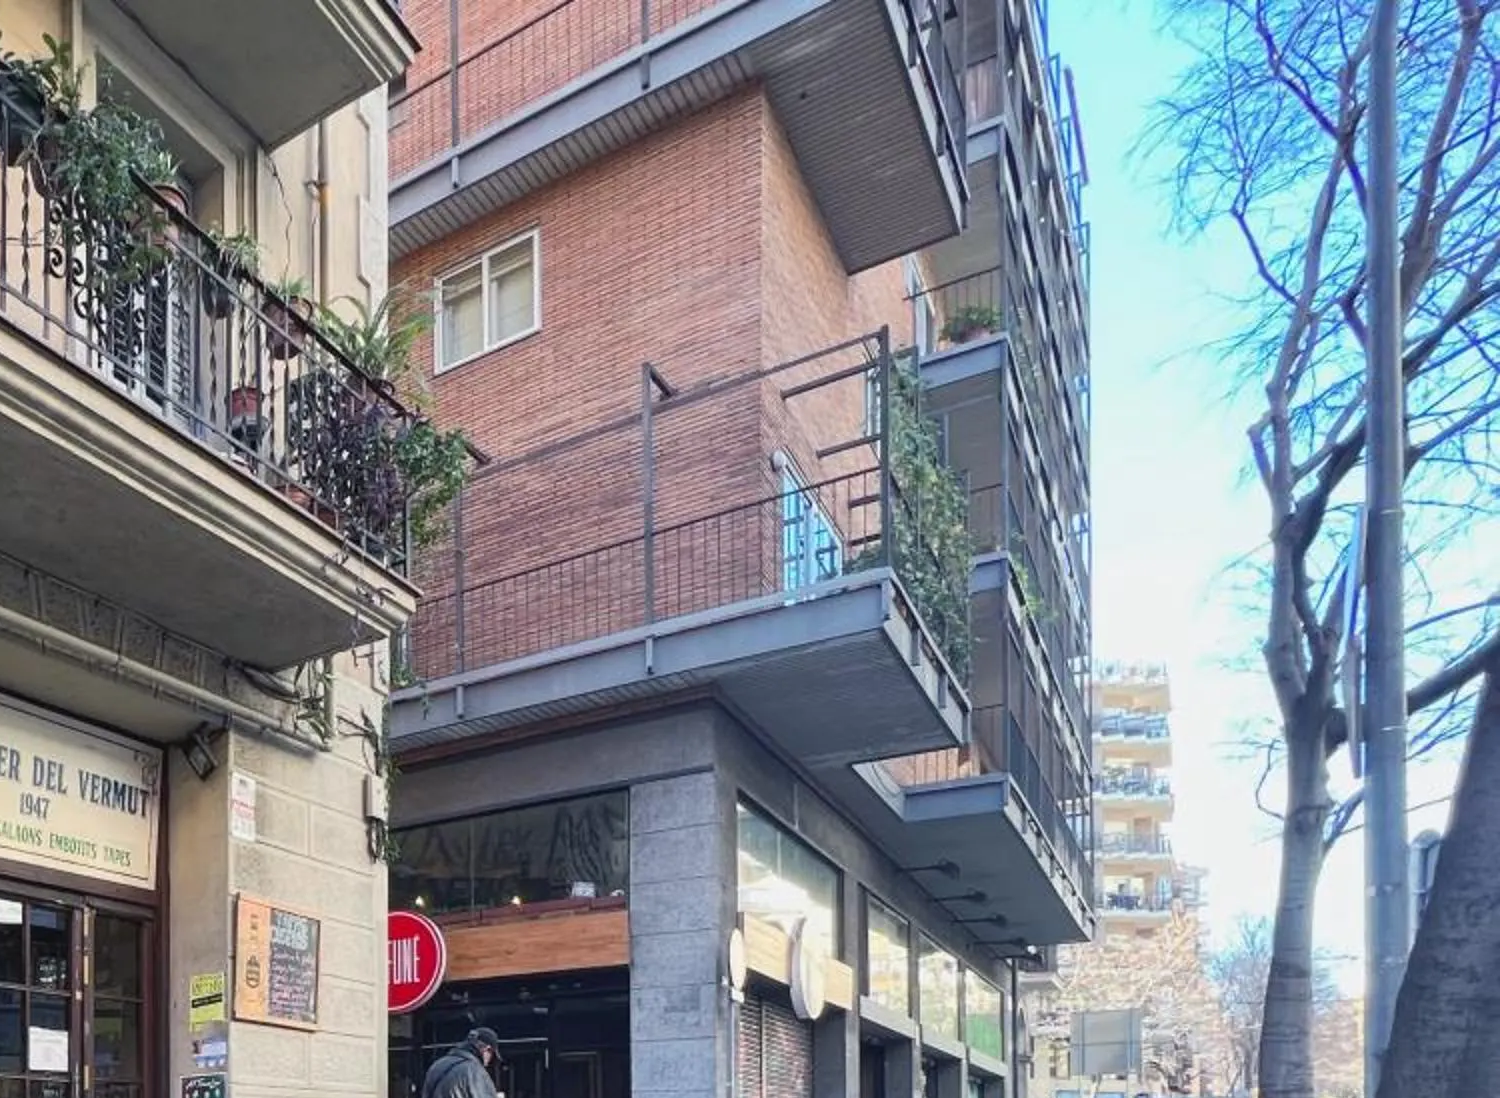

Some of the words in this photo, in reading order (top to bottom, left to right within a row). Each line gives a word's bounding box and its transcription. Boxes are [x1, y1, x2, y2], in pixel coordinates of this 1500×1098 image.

[20, 792, 50, 821] 1947
[33, 755, 67, 795] DEL
[78, 768, 150, 818] VERMUT
